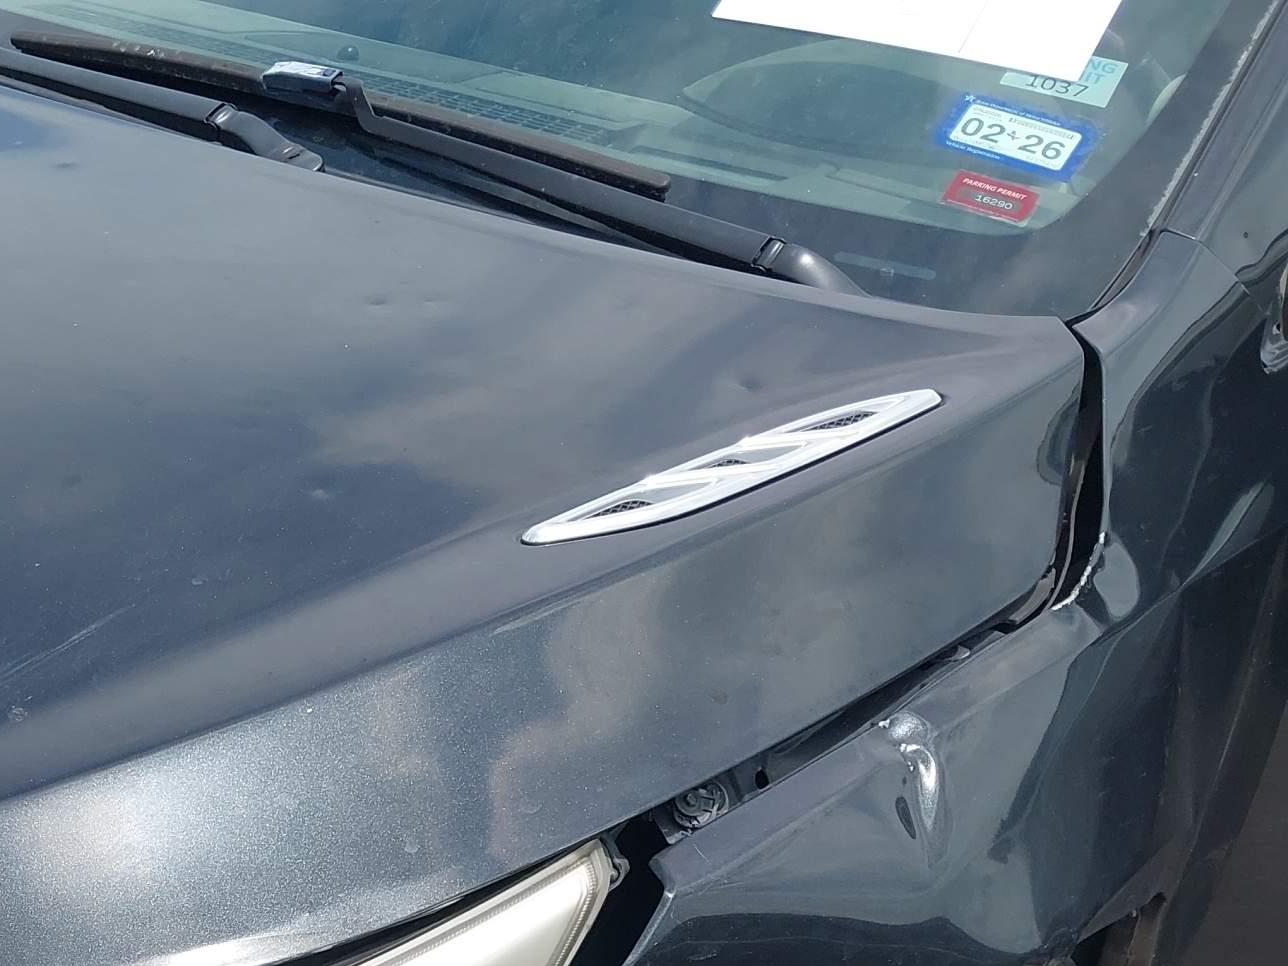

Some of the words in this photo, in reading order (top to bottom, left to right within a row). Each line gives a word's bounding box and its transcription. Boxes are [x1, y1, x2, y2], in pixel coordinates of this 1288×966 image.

[1026, 74, 1089, 97] 1037
[960, 117, 1006, 144] 02
[1017, 134, 1066, 160] 26
[962, 177, 996, 192] PARKING
[996, 186, 1028, 200] PERMIT
[975, 194, 1013, 210] 16290
